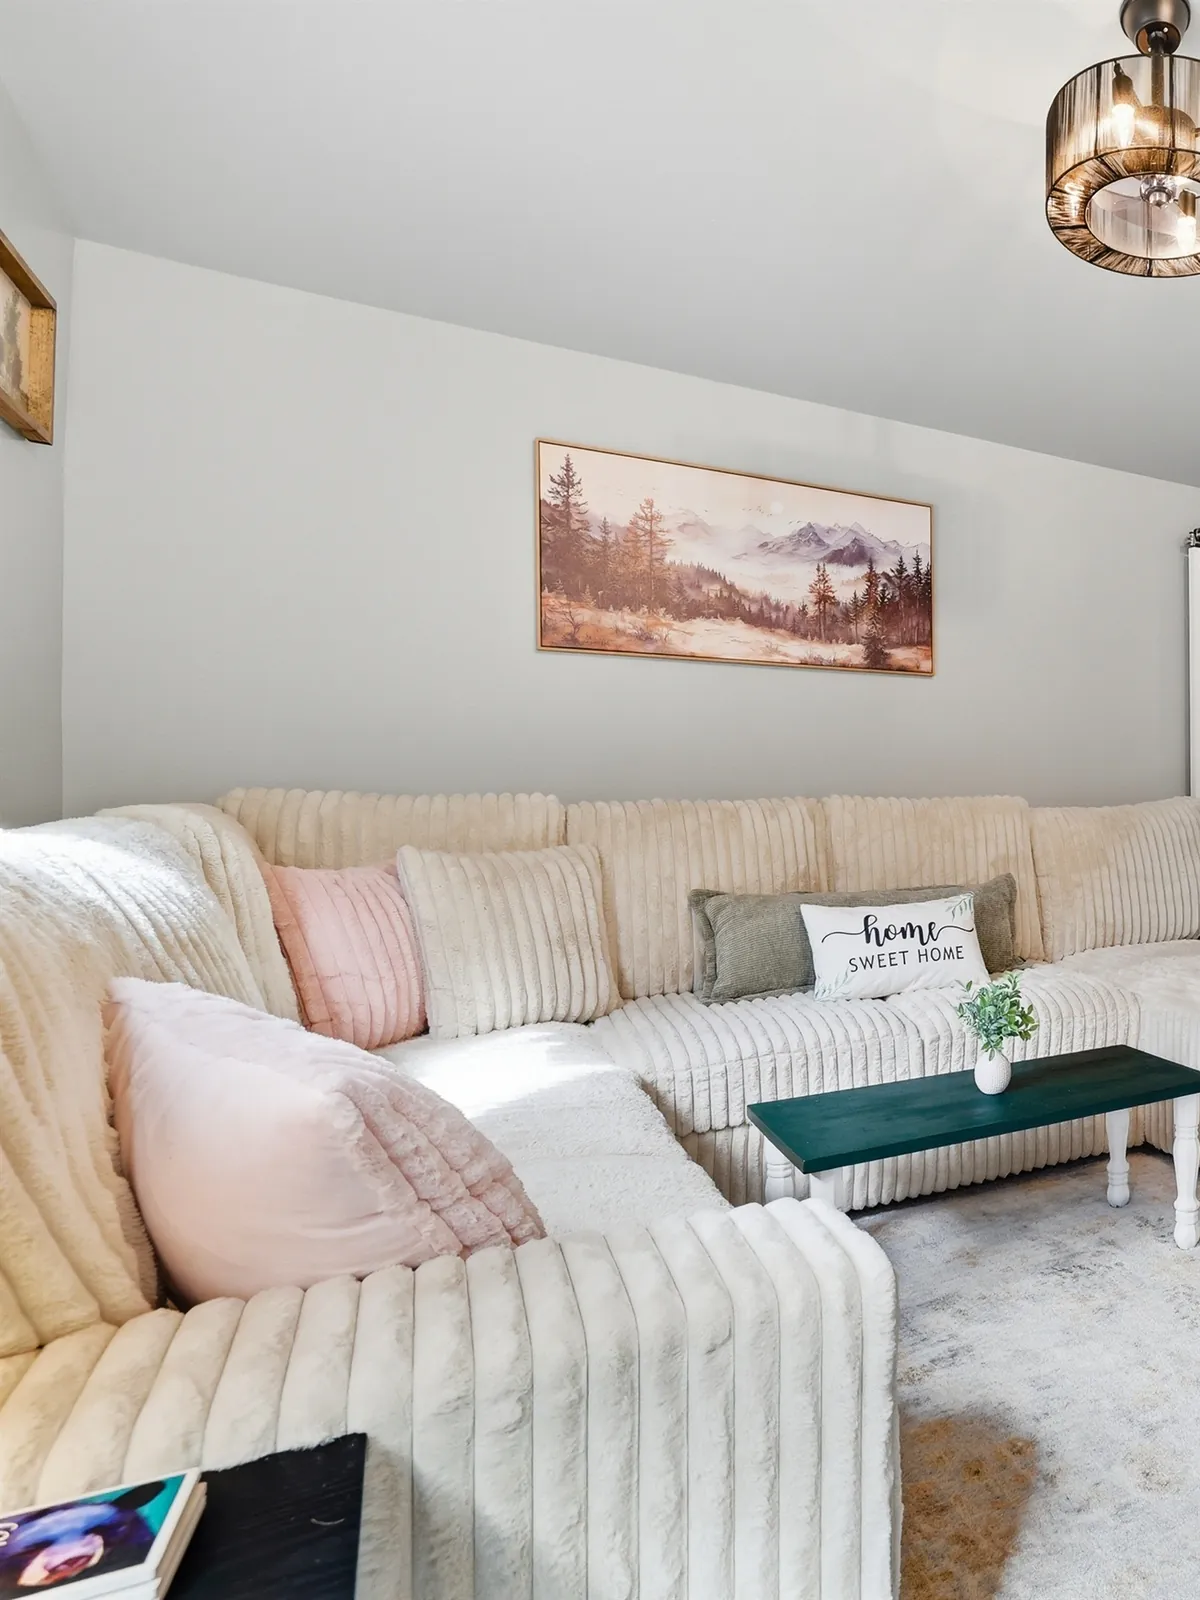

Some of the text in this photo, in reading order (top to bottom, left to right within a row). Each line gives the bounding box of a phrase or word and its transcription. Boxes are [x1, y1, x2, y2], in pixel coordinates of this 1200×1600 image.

[822, 914, 974, 947] home
[849, 945, 964, 973] SWEET HOME
